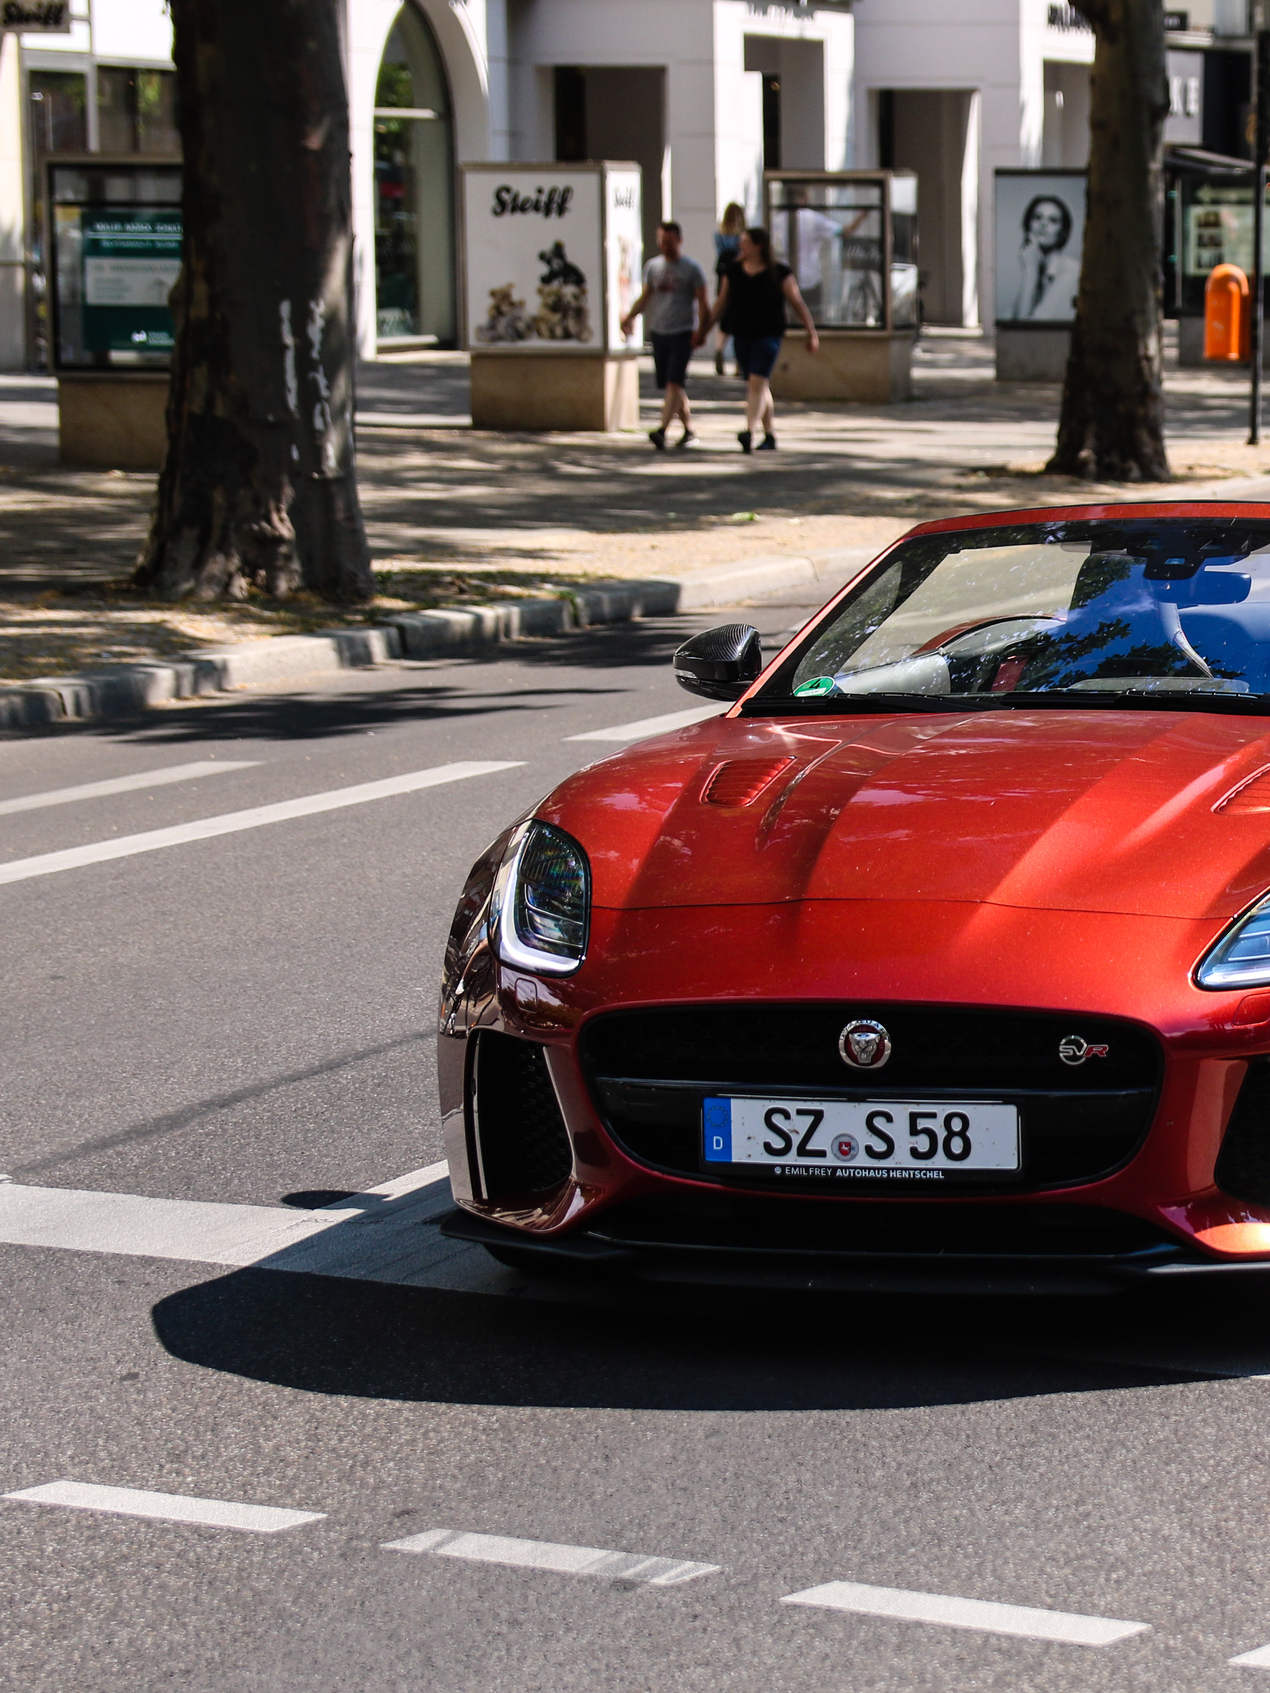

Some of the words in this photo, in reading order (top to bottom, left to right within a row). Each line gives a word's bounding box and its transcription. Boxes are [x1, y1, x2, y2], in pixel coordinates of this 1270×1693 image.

[492, 184, 573, 218] Steiff
[809, 678, 821, 689] 4
[1059, 1040, 1109, 1060] SVR
[713, 1136, 723, 1150] D
[763, 1106, 827, 1158] SZ
[864, 1109, 896, 1160] S
[909, 1110, 972, 1161] 58
[785, 1166, 808, 1176] EMIL
[808, 1167, 832, 1176] FREY
[836, 1168, 888, 1178] AUTOHAUS
[889, 1169, 945, 1179] HENTSCHEL
